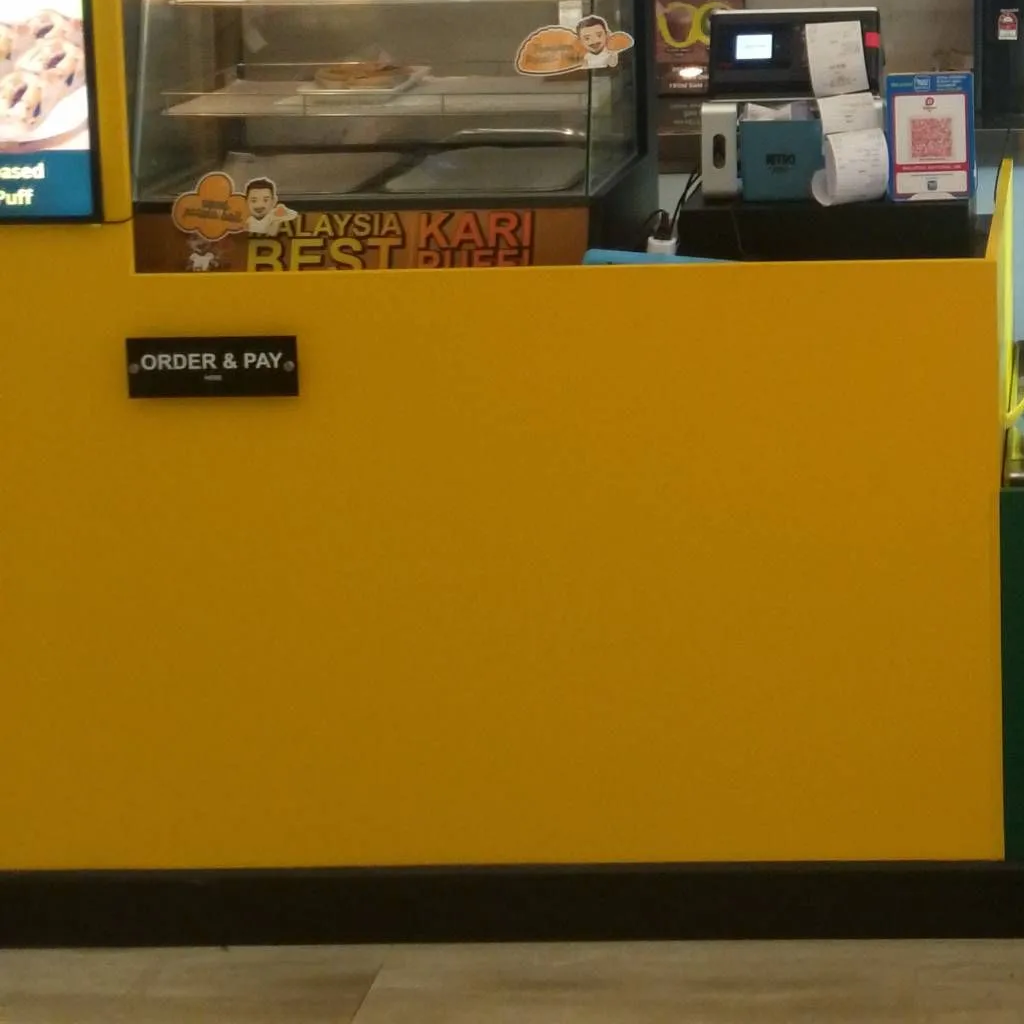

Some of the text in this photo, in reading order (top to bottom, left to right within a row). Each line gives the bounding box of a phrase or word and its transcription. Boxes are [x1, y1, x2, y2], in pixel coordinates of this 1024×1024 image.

[420, 211, 532, 248] KARI
[140, 352, 282, 371] ORDER & PAY
